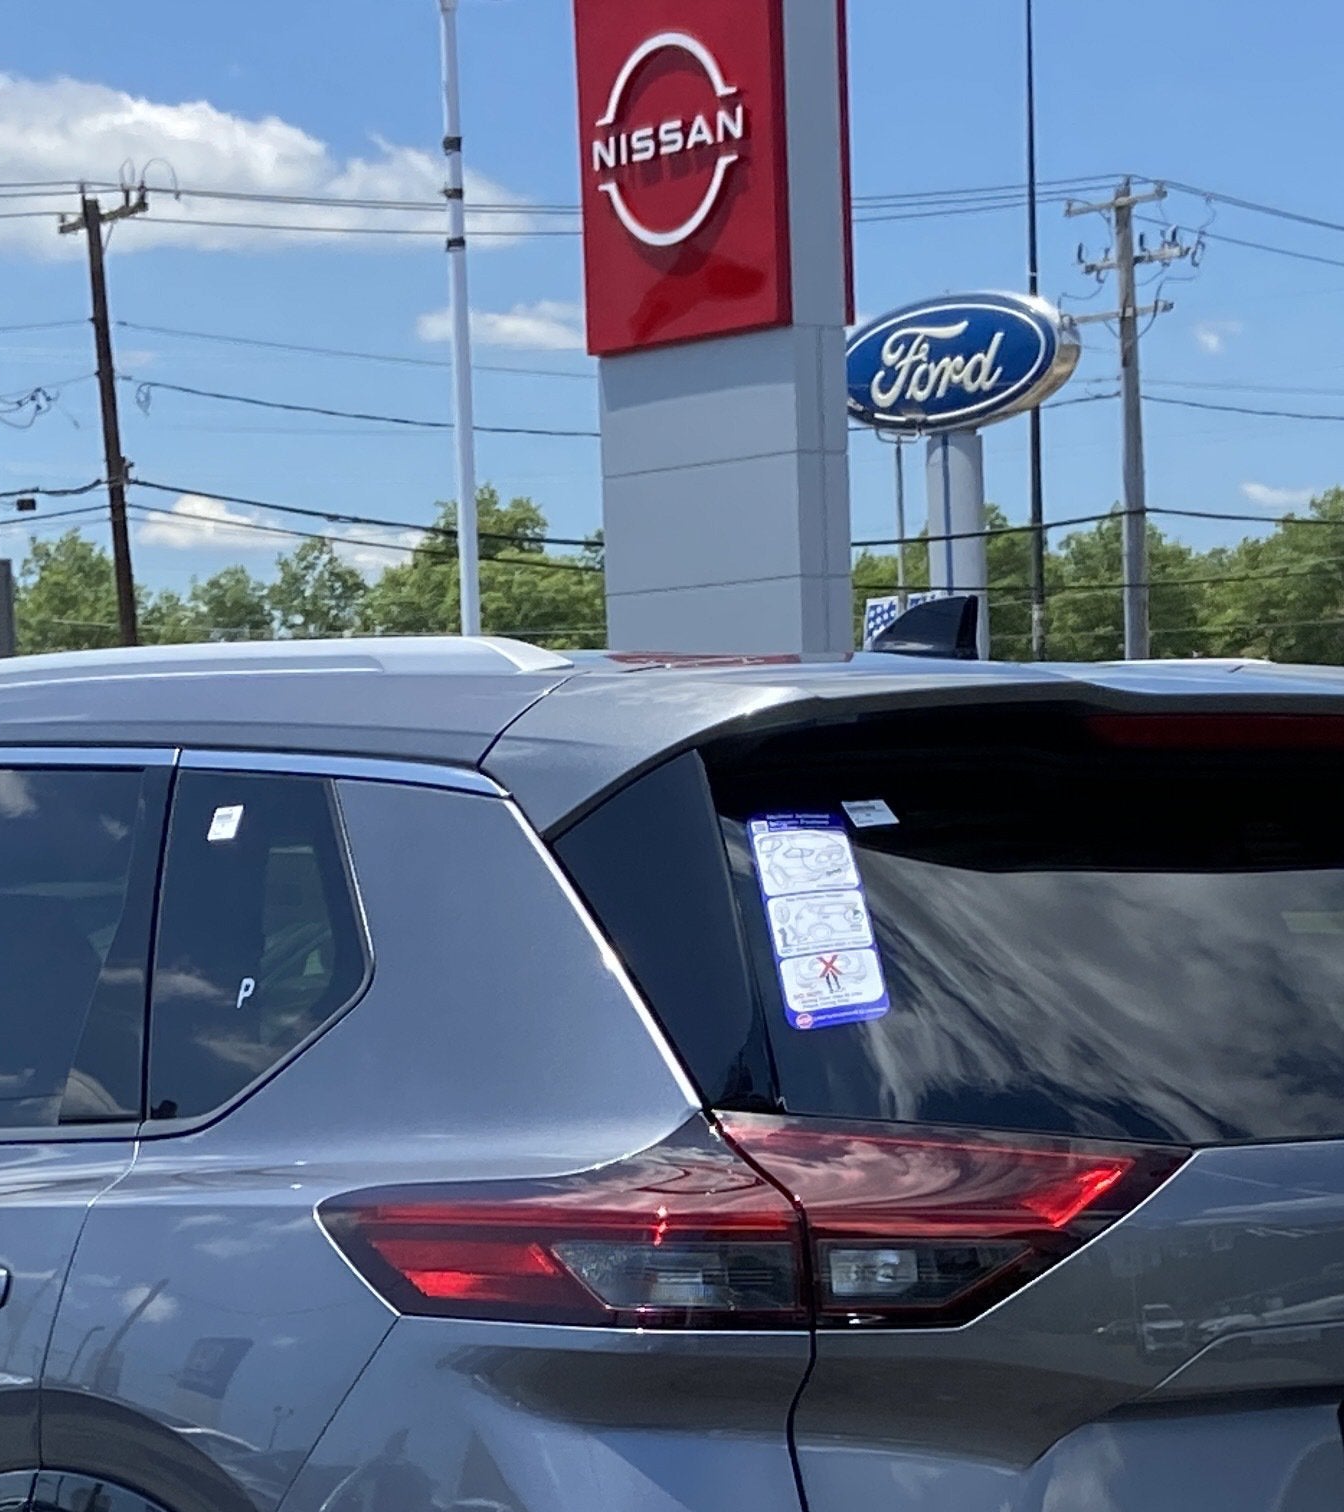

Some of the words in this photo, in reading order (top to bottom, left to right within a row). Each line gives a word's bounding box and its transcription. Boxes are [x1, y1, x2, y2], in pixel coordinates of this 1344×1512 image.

[592, 104, 744, 171] NISSAN
[870, 320, 1005, 409] Ford
[236, 976, 256, 1009] P
